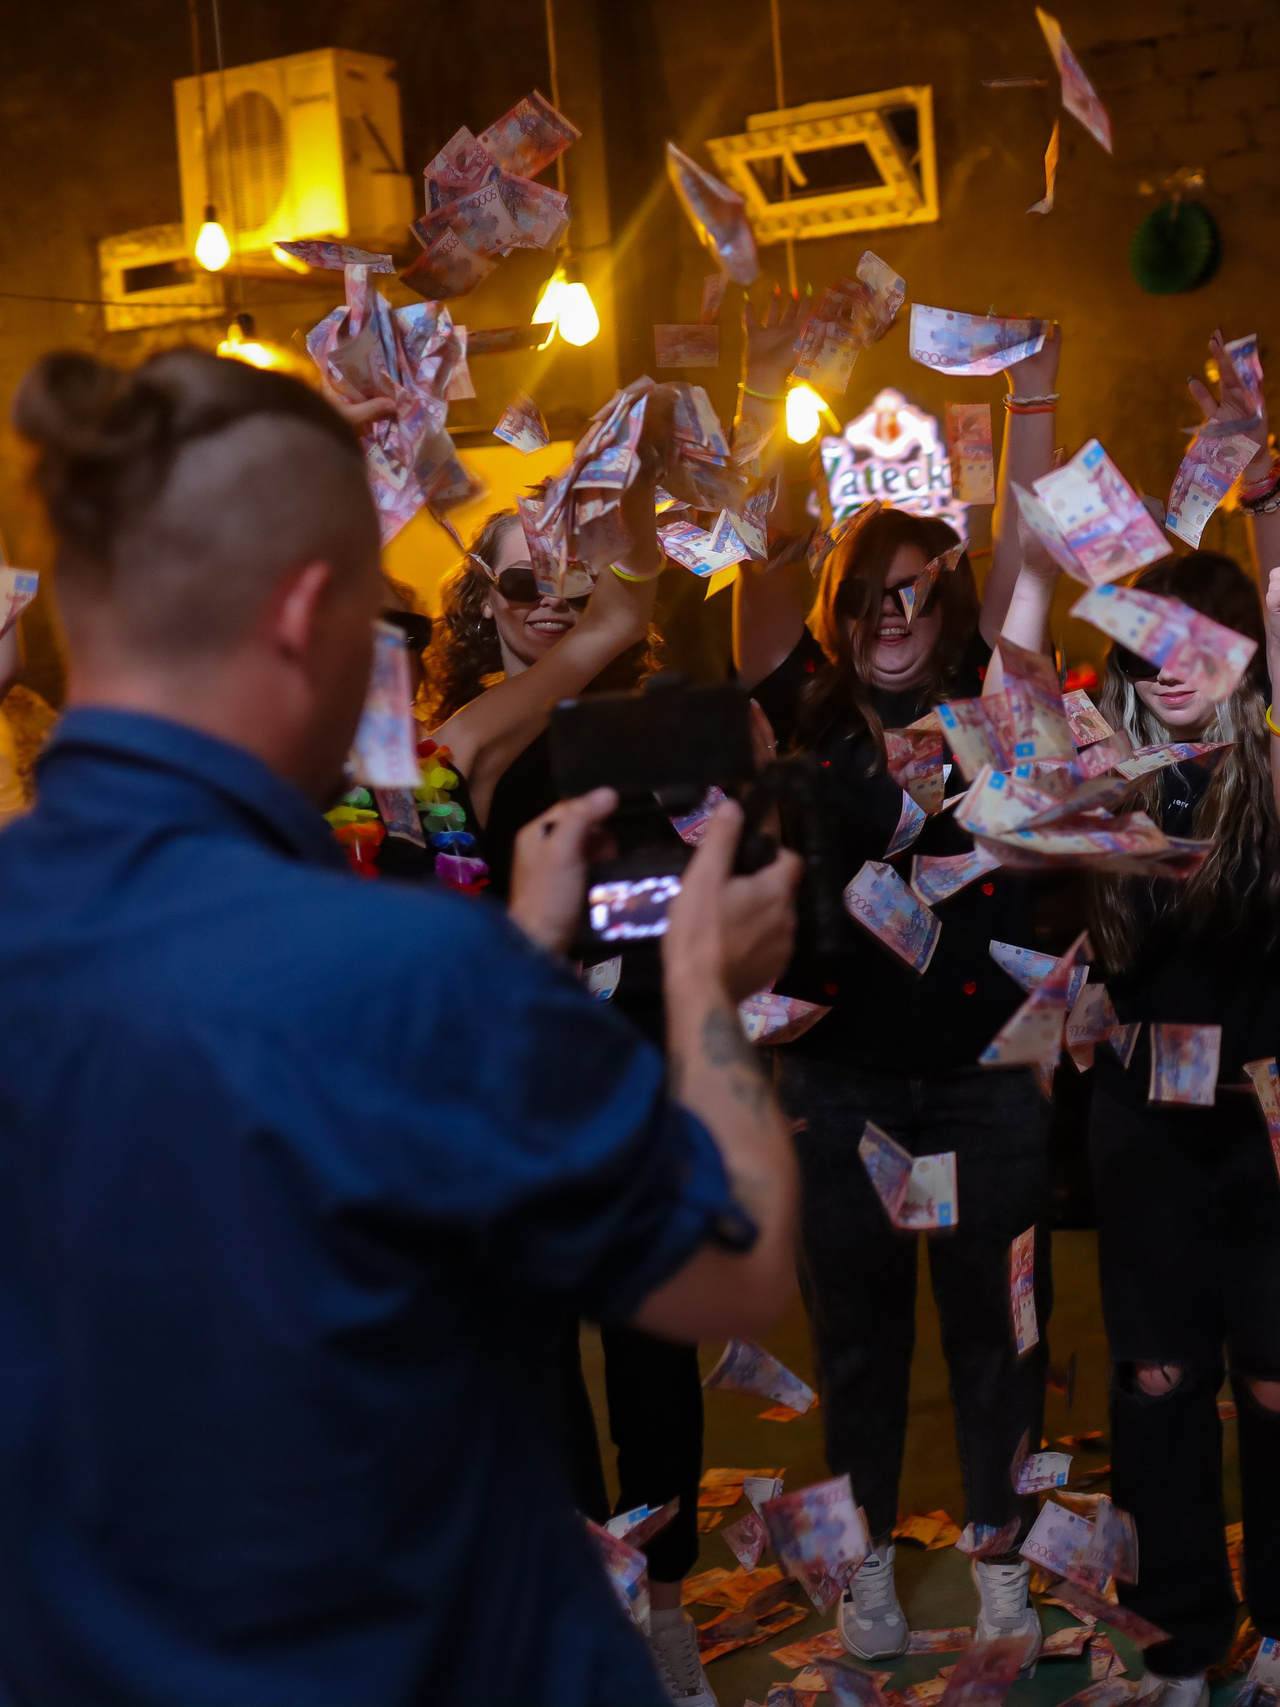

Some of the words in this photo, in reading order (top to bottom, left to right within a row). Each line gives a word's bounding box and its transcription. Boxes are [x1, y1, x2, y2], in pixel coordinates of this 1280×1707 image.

[468, 189, 500, 210] 5000
[915, 349, 954, 366] 5000
[846, 889, 873, 916] 5000
[1026, 1541, 1054, 1561] 5000
